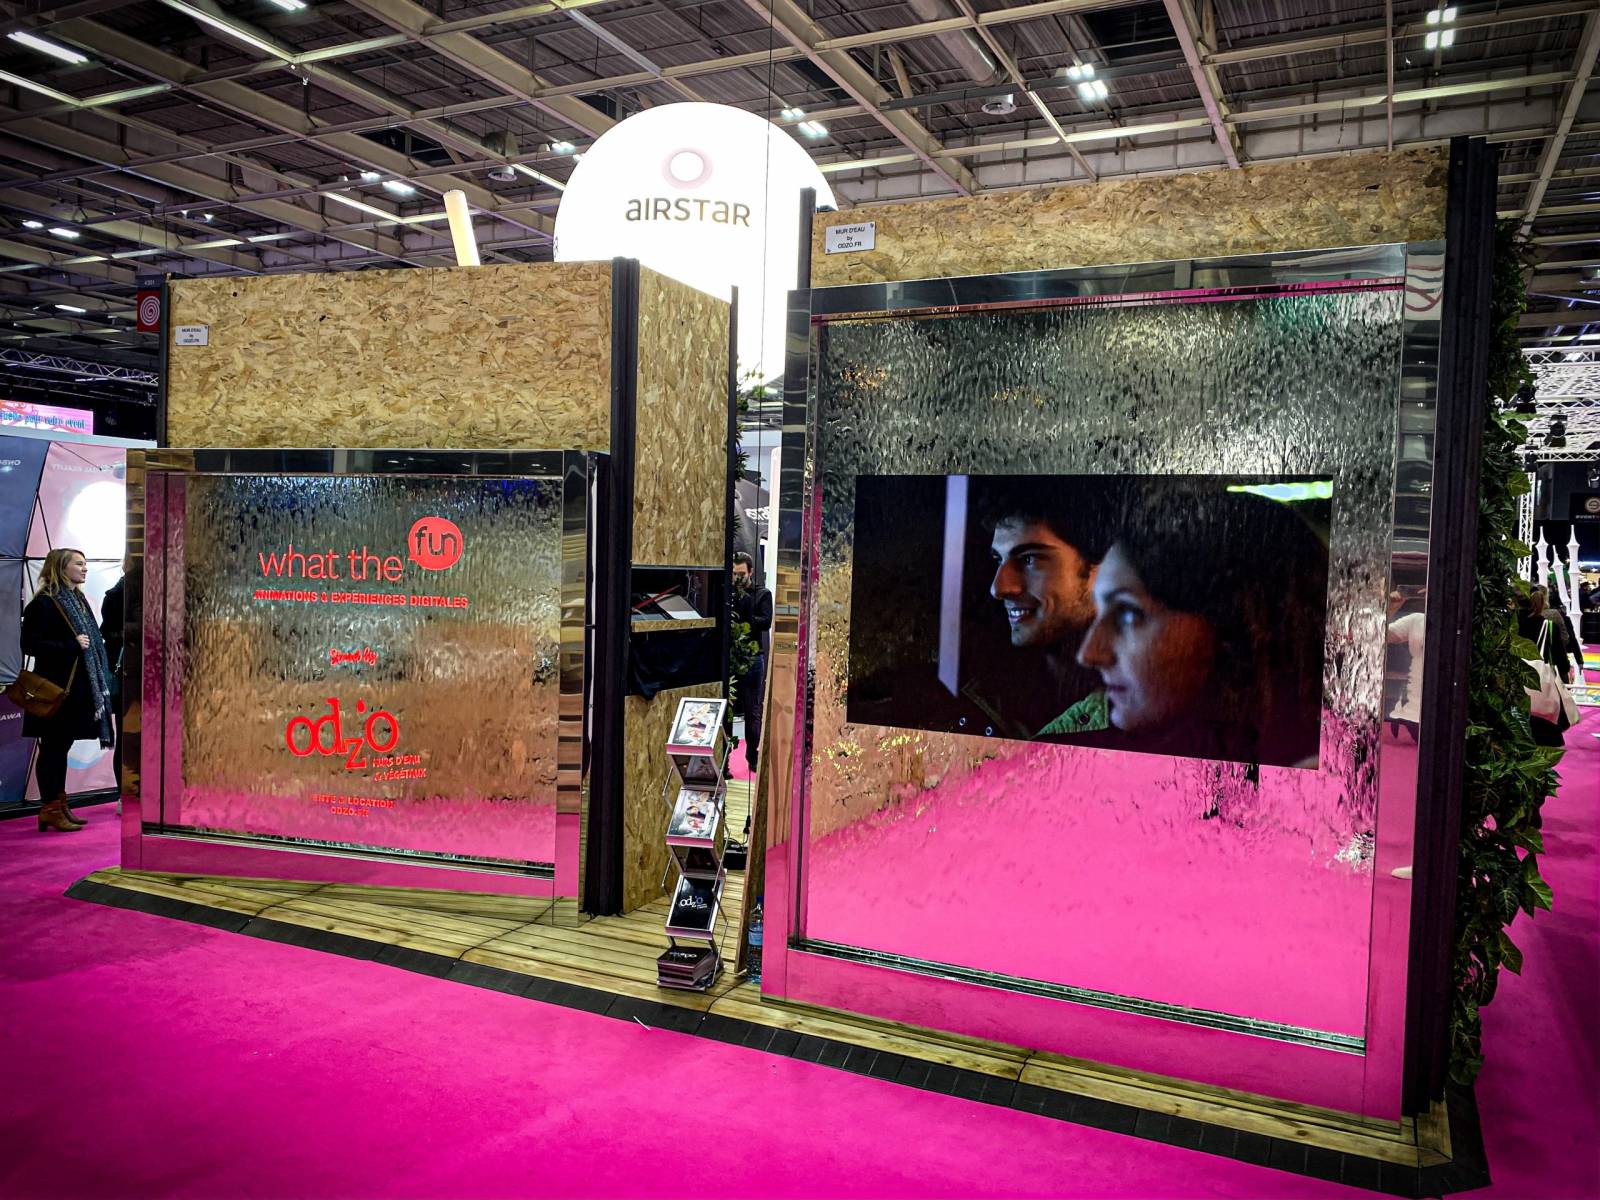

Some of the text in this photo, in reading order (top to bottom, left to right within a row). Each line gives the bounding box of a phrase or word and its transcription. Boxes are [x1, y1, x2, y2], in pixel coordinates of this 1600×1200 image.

[258, 526, 458, 581] what the fun
[253, 588, 318, 602] ANIMATIONS
[410, 596, 469, 609] DIGITALES
[347, 796, 395, 809] LOCATION
